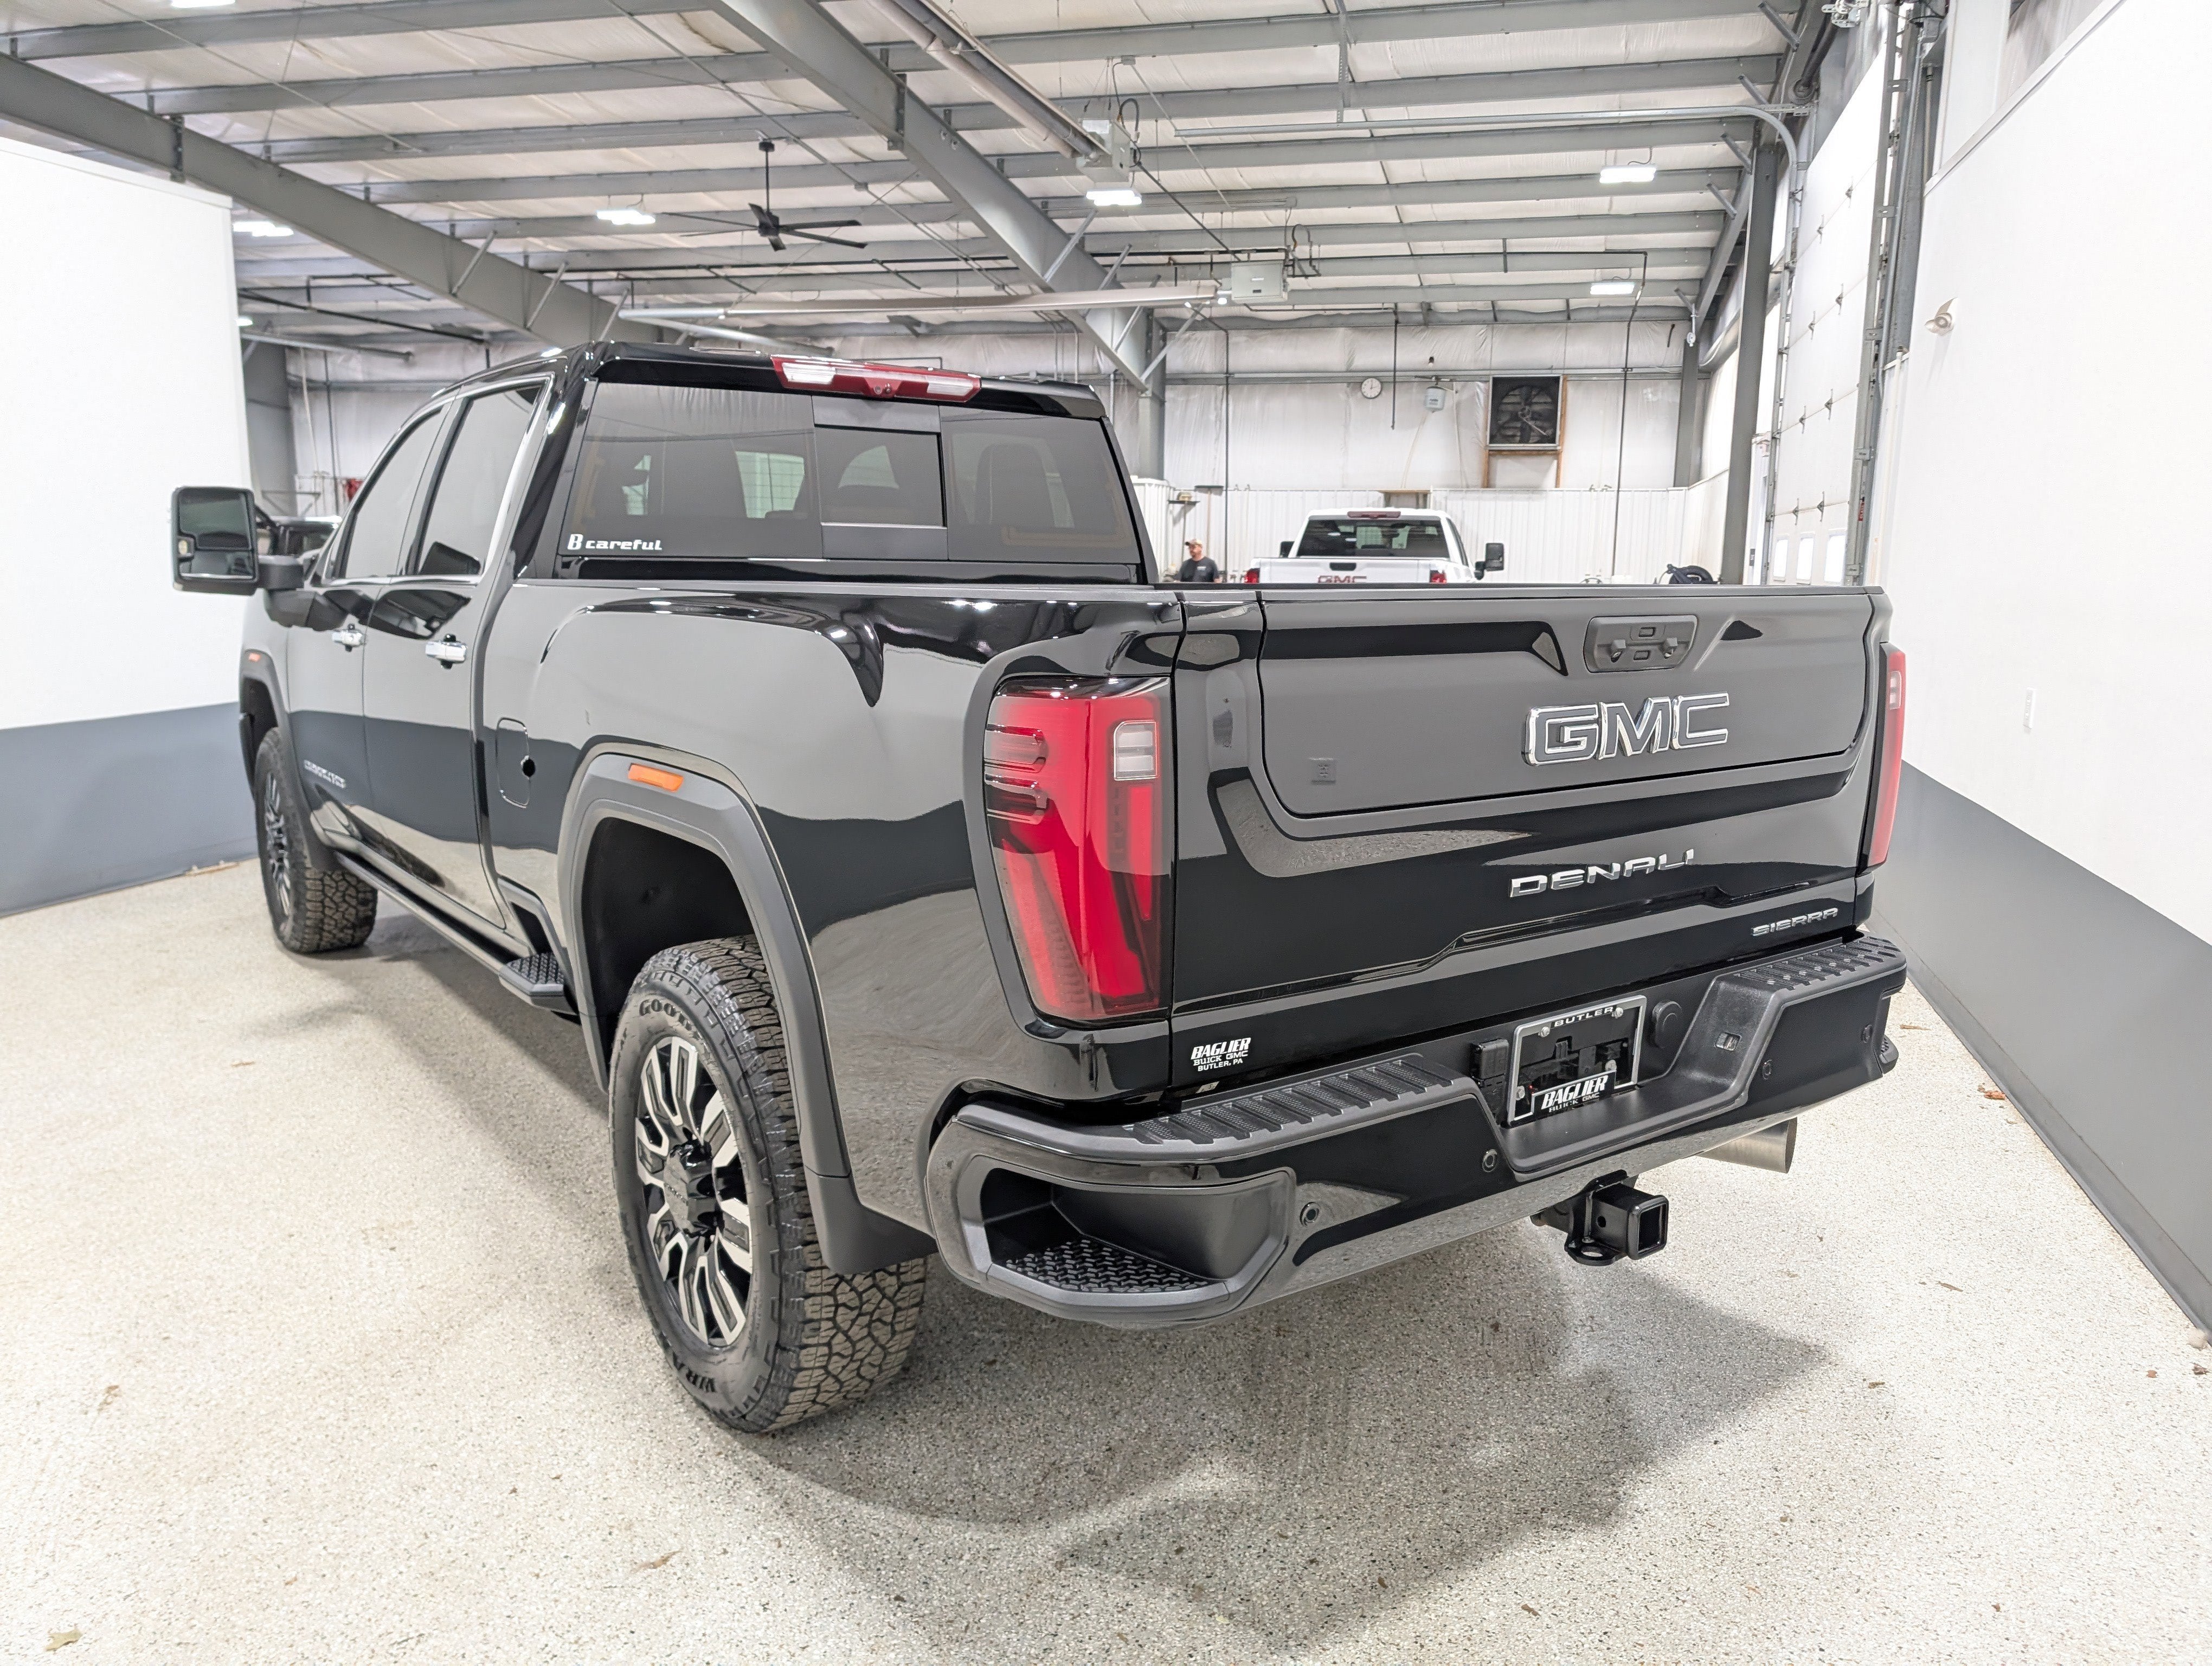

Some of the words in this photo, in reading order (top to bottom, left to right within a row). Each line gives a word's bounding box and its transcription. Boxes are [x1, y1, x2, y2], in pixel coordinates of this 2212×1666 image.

[567, 534, 583, 550] B
[586, 540, 662, 550] careful
[1523, 691, 1729, 766] GMC
[1509, 848, 1694, 897] DENALI
[1751, 908, 1838, 936] SIERRA
[1554, 1006, 1614, 1027] BUTLER
[1191, 1037, 1251, 1060] BAGLIER
[1193, 1055, 1222, 1066] BUICK
[1226, 1050, 1249, 1060] GMC
[1198, 1061, 1232, 1072] BUTLER,
[1541, 1075, 1609, 1110] BAGLIER
[1582, 1092, 1600, 1101] GMC
